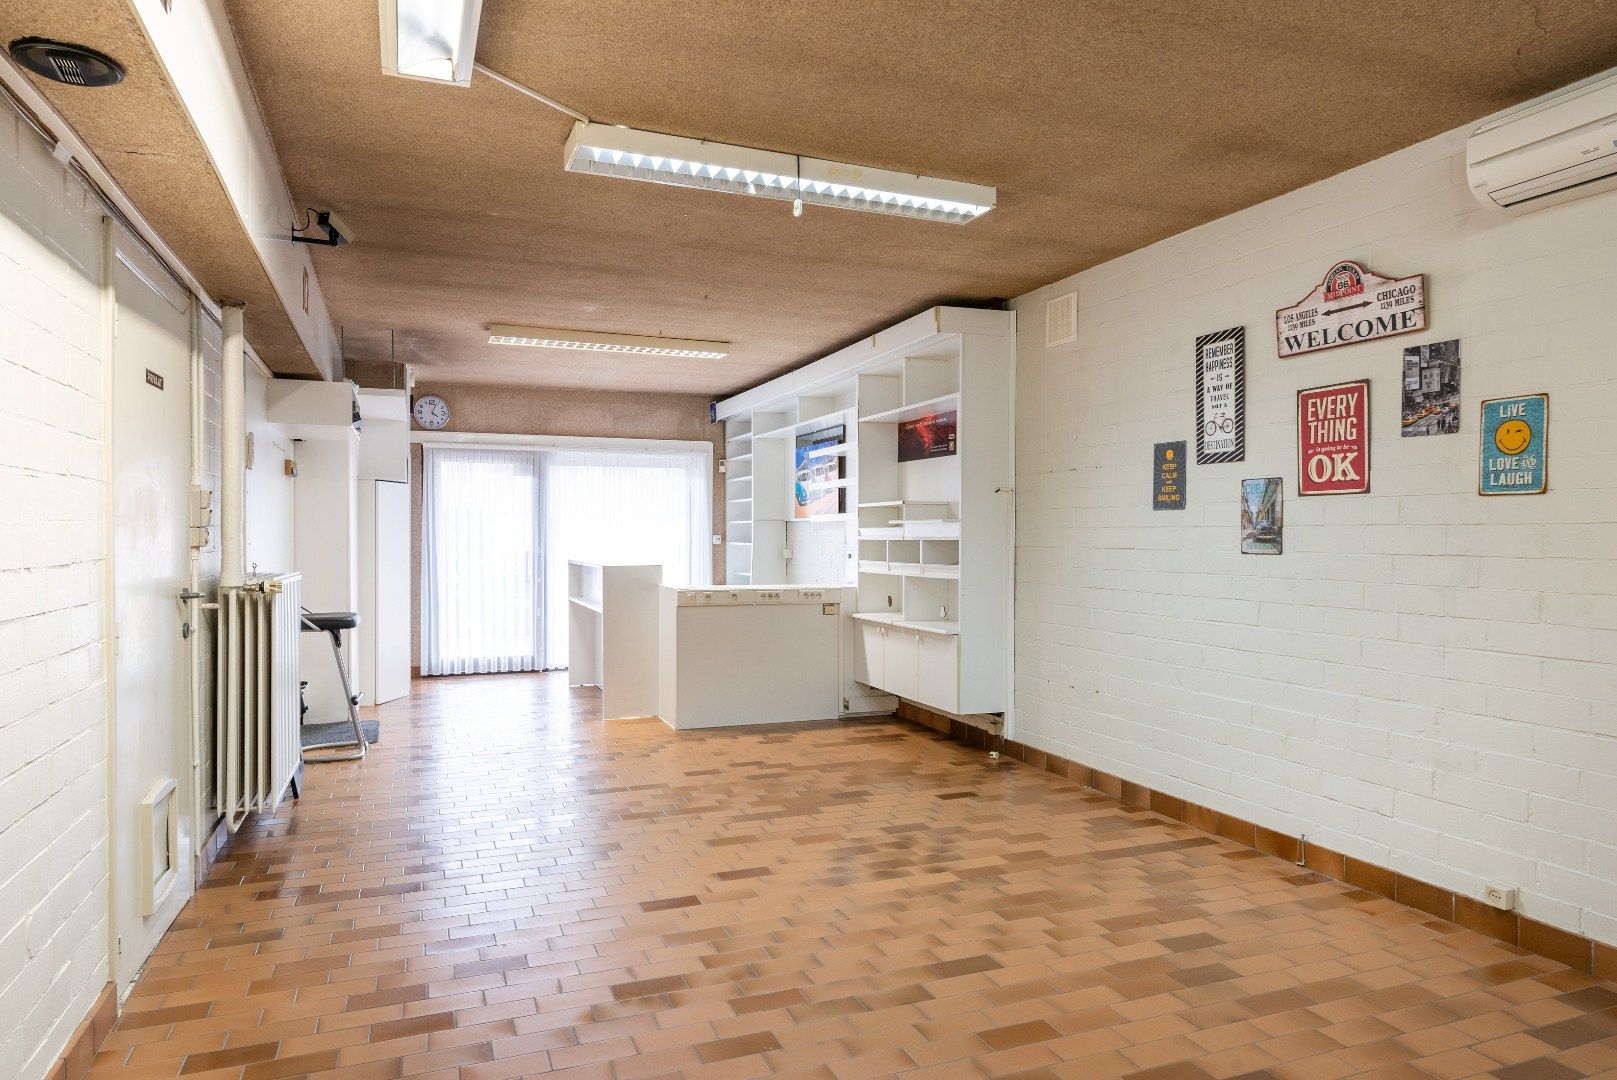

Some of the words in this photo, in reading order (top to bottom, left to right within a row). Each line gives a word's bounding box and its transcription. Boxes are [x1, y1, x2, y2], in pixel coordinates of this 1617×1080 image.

[1338, 280, 1349, 289] 66
[1327, 285, 1362, 300] MIDPOINT
[1377, 285, 1416, 302] CHICAGO
[1395, 295, 1415, 306] MILES
[1284, 314, 1294, 324] LOS
[1295, 308, 1318, 321] ANGELES
[1300, 318, 1316, 328] MILES
[1284, 309, 1417, 352] WELCOME
[1205, 343, 1234, 360] REMEMBER
[1205, 356, 1233, 373] HAPPINESS
[1216, 373, 1223, 382] IS
[1206, 386, 1211, 394] A
[1212, 384, 1224, 393] WAY
[1225, 382, 1233, 390] OF
[1210, 393, 1229, 403] TRAVEL
[1307, 392, 1358, 422] EVERY
[1500, 403, 1526, 418] LIVE
[1308, 417, 1357, 445] THING
[1204, 437, 1235, 451] DESTINATION
[1320, 445, 1336, 454] going
[1162, 463, 1177, 471] KEEP
[1307, 452, 1360, 483] OK
[1489, 457, 1519, 471] LOVE
[1490, 471, 1533, 486] LAUGH
[1157, 494, 1180, 502] SMILING
